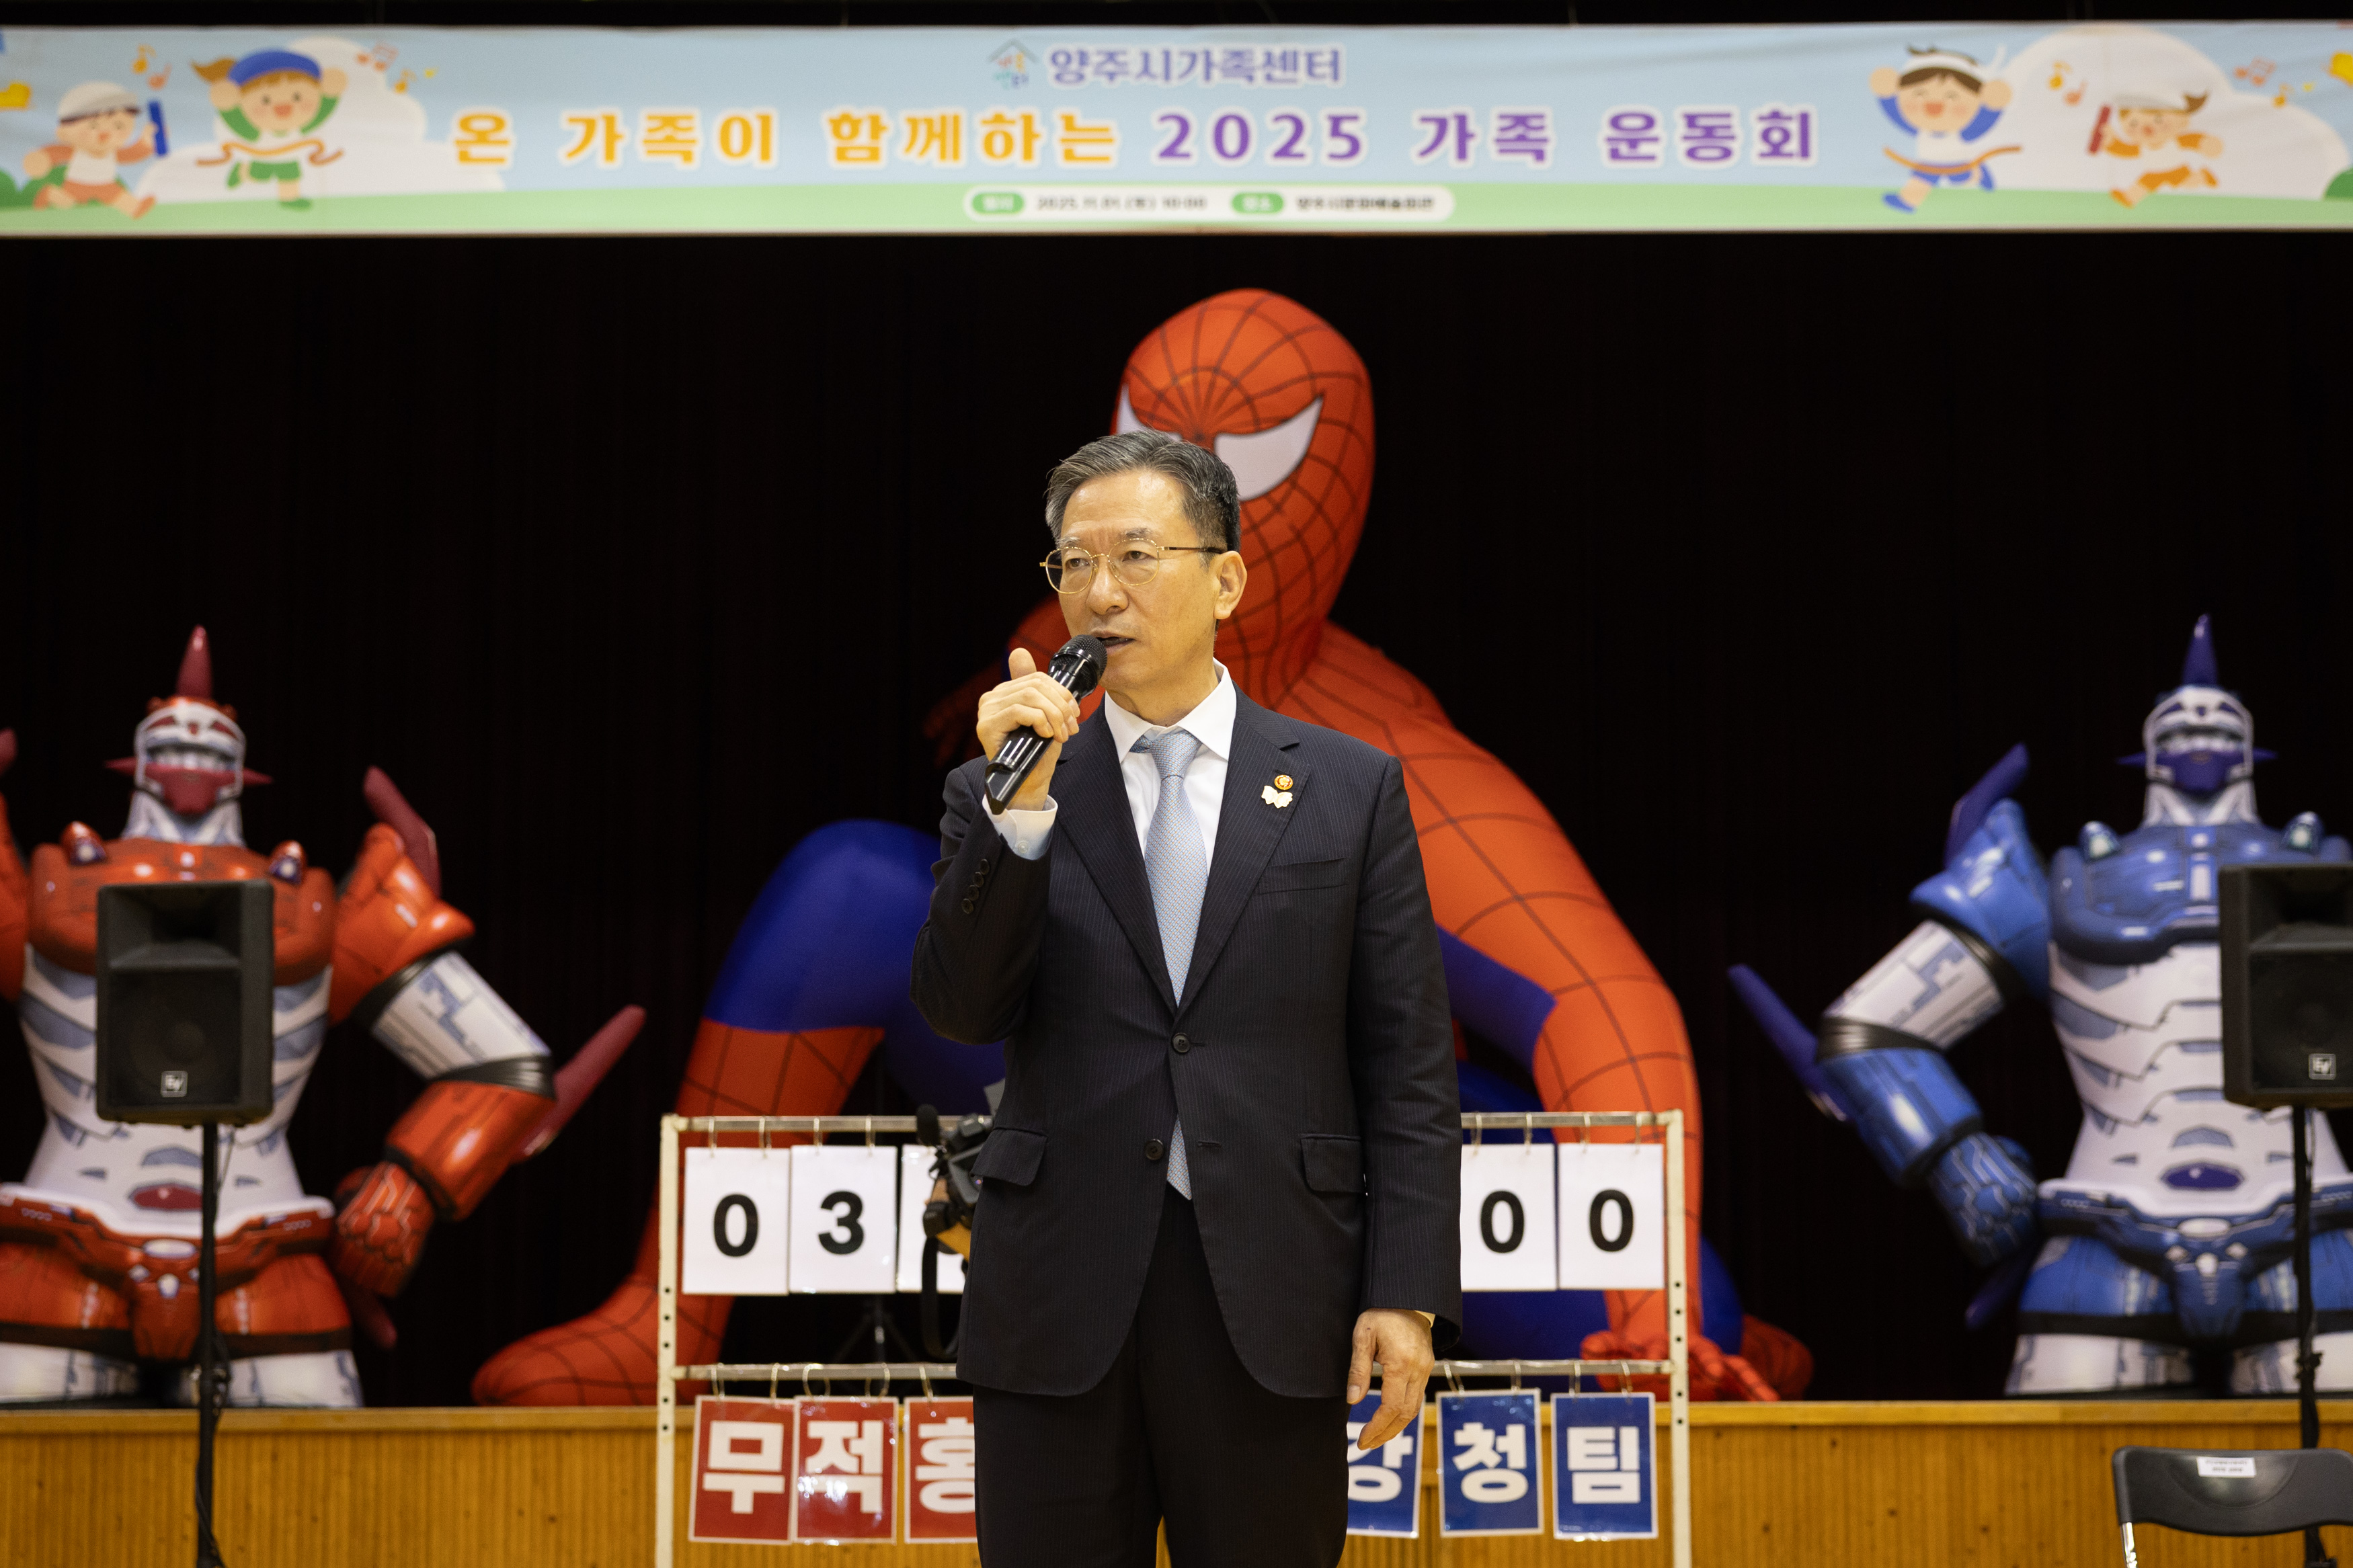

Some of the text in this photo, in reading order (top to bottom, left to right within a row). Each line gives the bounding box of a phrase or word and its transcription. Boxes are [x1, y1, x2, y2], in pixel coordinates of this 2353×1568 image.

[1049, 48, 1342, 84] 양주시가족센터
[453, 109, 1811, 165] 온 가족이 함께하는 2025 가족 운동회
